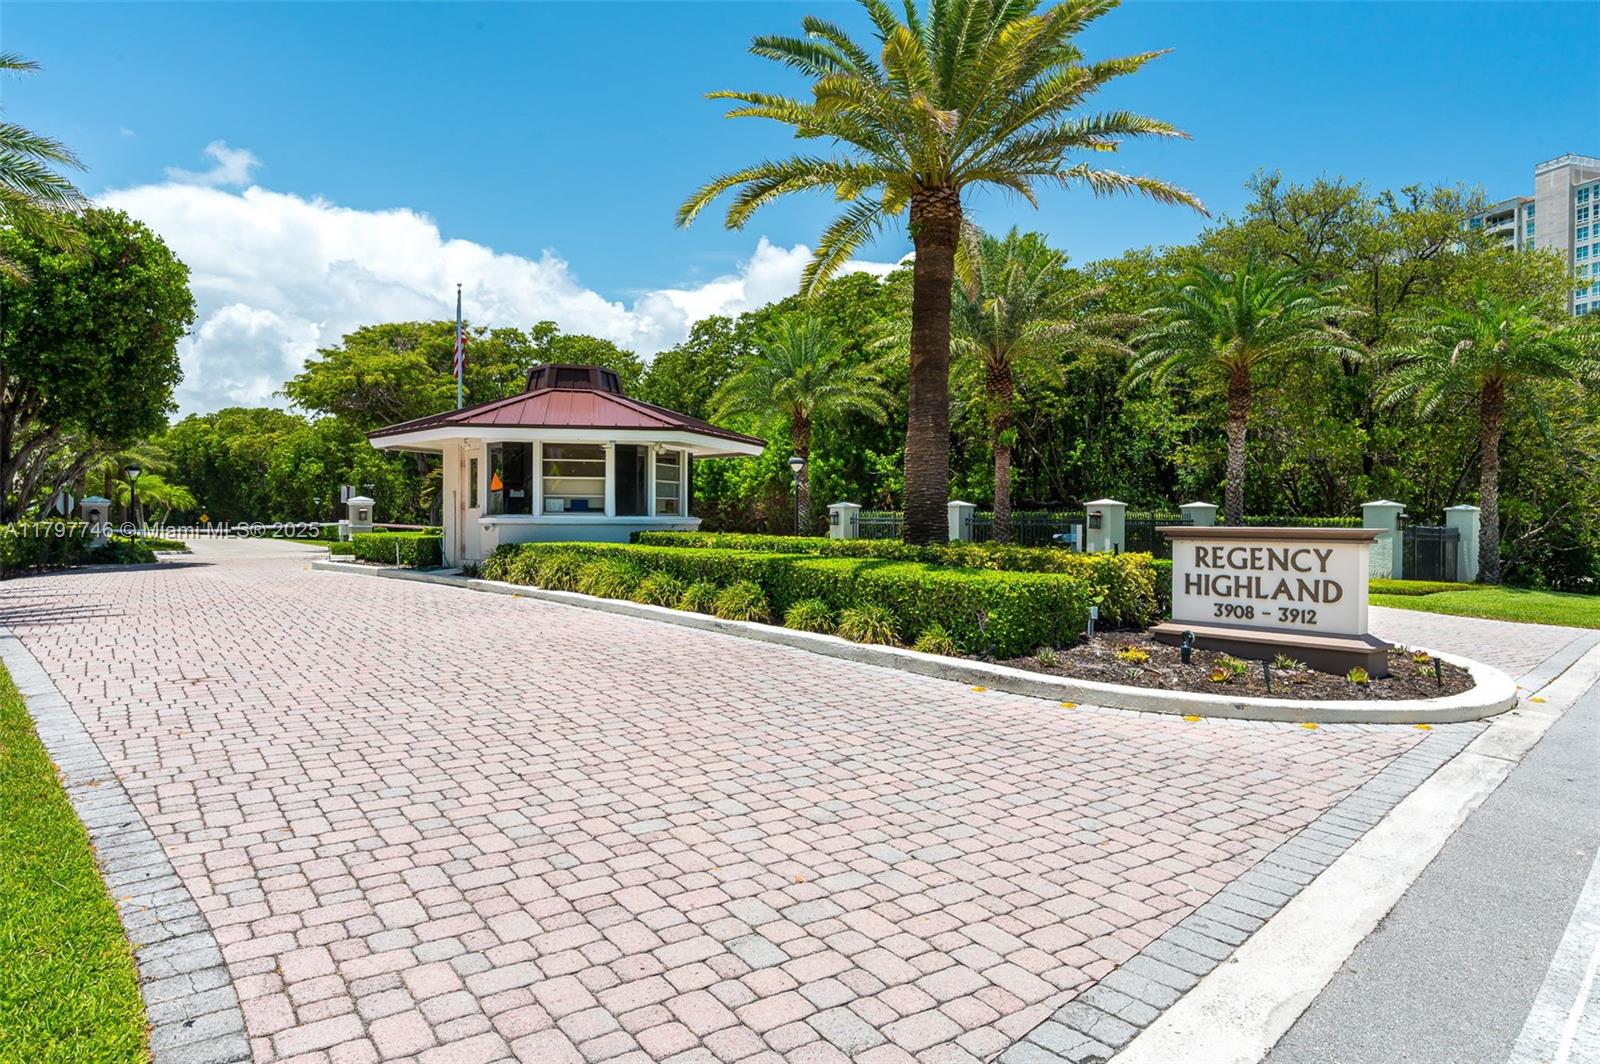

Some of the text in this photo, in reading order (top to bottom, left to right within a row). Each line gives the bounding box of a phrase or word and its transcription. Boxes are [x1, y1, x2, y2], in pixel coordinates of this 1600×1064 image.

[1194, 546, 1334, 573] REGENCY
[1184, 573, 1344, 604] HIGHLAND
[1213, 603, 1255, 619] 3908
[1278, 607, 1317, 625] 3912
